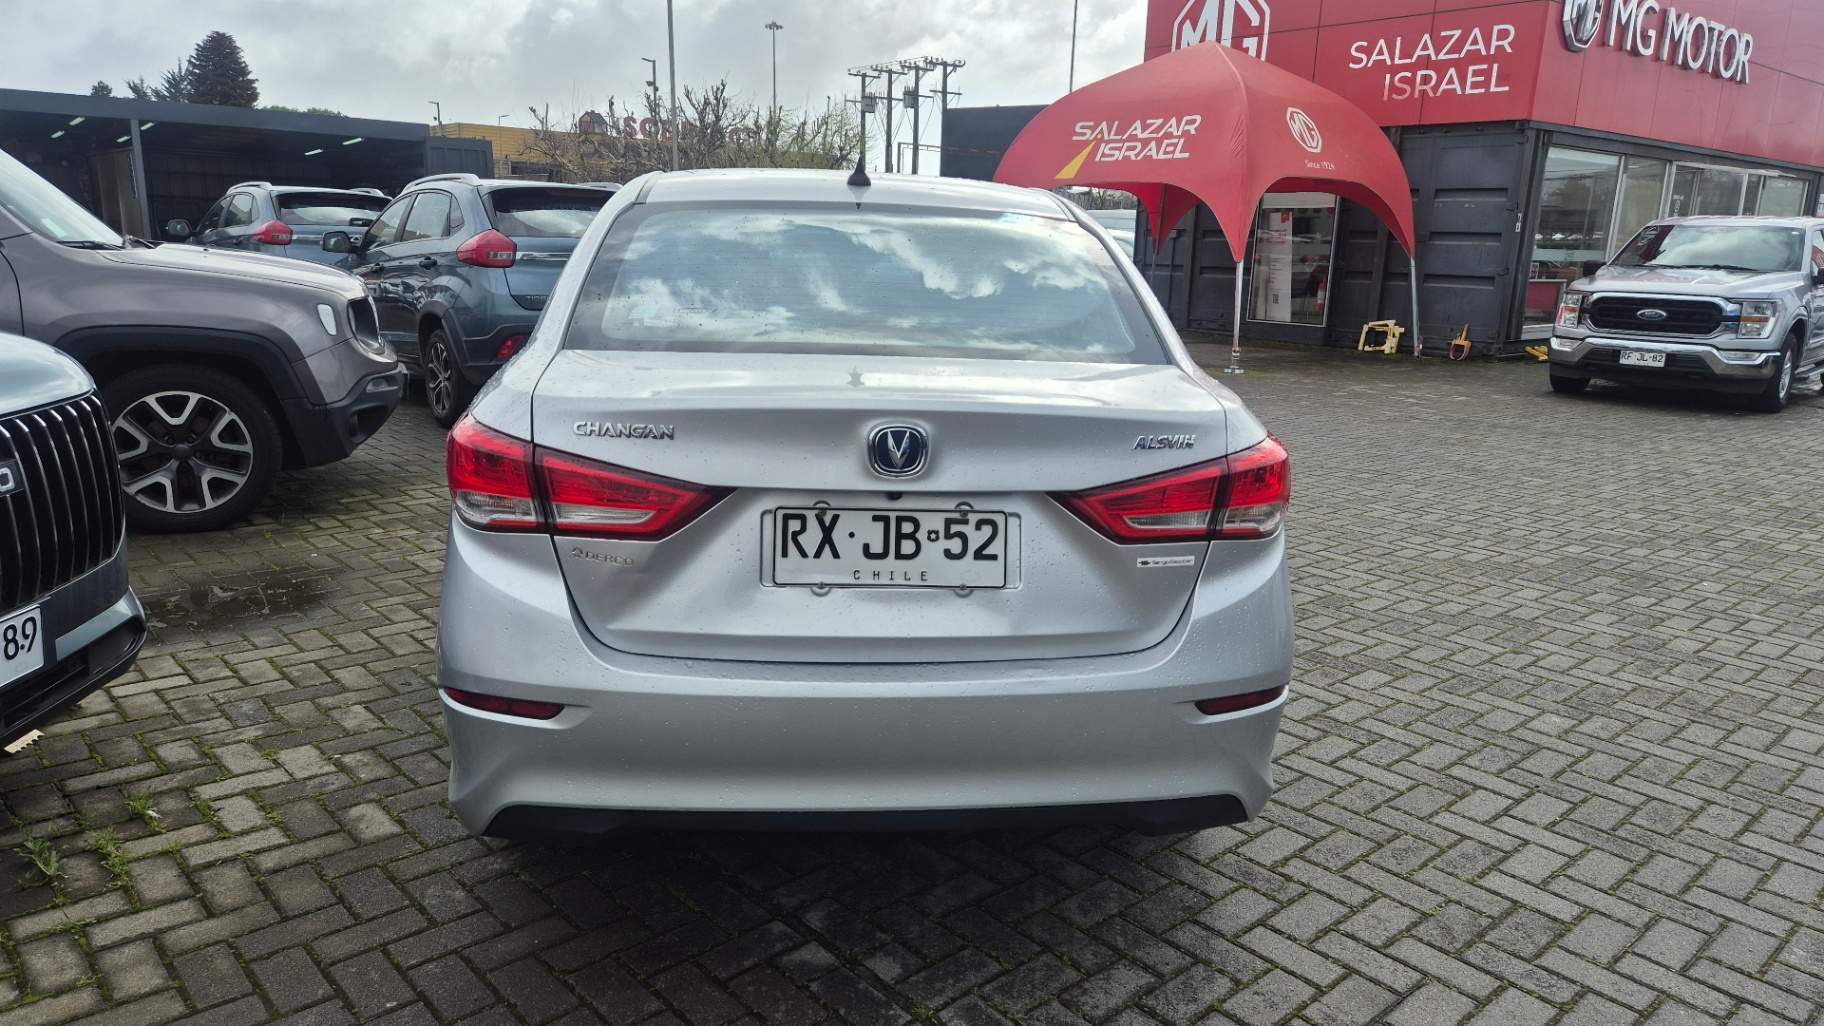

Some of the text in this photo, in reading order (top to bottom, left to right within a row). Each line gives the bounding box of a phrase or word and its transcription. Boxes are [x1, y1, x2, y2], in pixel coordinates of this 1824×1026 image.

[1348, 24, 1516, 69] SALAZAR
[1606, 0, 1754, 84] MG MOTOR
[1383, 63, 1510, 101] ISRAEL
[1072, 114, 1201, 141] SALAZAR
[1289, 110, 1320, 150] MG
[1095, 138, 1191, 162] ISRAEL
[573, 421, 675, 441] CHANGAN
[585, 551, 634, 566] DERCO
[853, 569, 928, 582] CHILE
